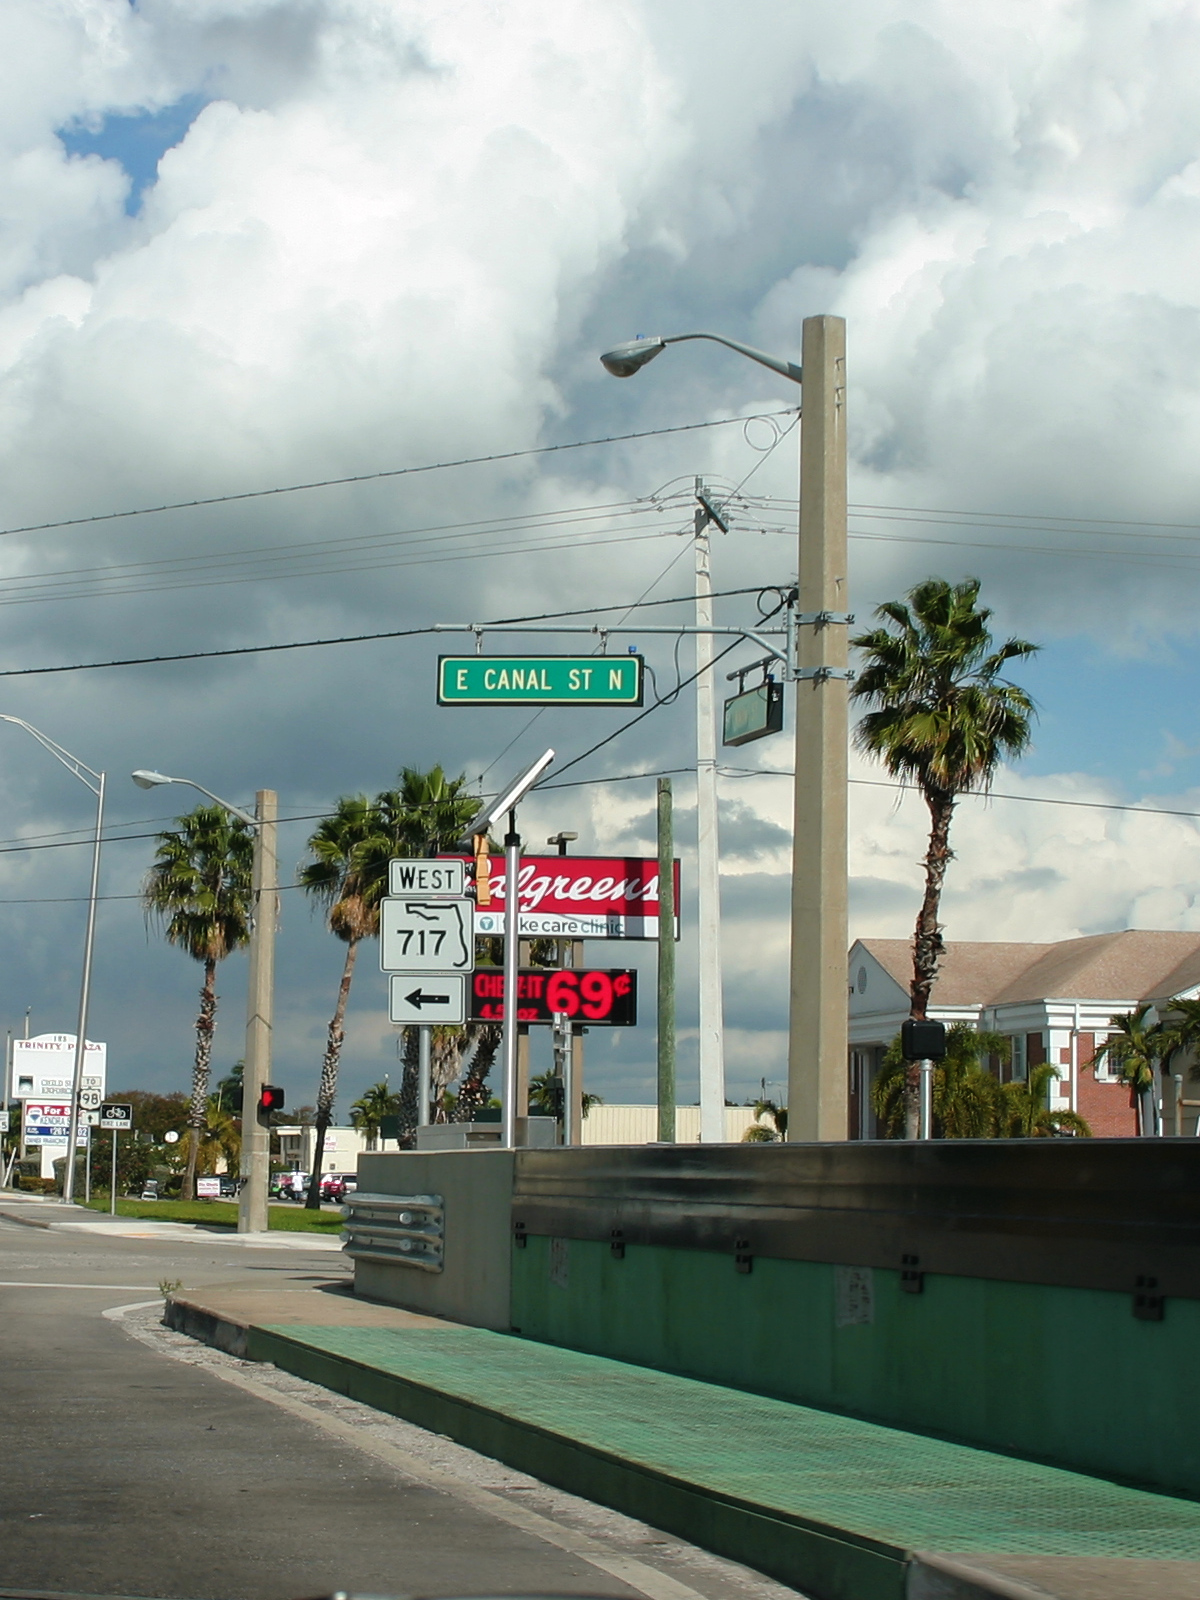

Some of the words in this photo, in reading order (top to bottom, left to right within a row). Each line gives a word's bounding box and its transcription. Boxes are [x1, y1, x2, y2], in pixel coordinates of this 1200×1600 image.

[456, 669, 468, 690] E
[484, 669, 552, 690] CANAL
[568, 669, 593, 690] ST
[609, 669, 622, 690] N
[399, 866, 455, 889] WEST
[541, 922, 578, 933] care
[580, 919, 625, 934] clinic
[397, 930, 447, 956] 717
[474, 973, 546, 999] CHEZ-IT
[18, 1042, 62, 1050] TRINITY
[82, 1093, 99, 1105] 98
[43, 1106, 62, 1115] For
